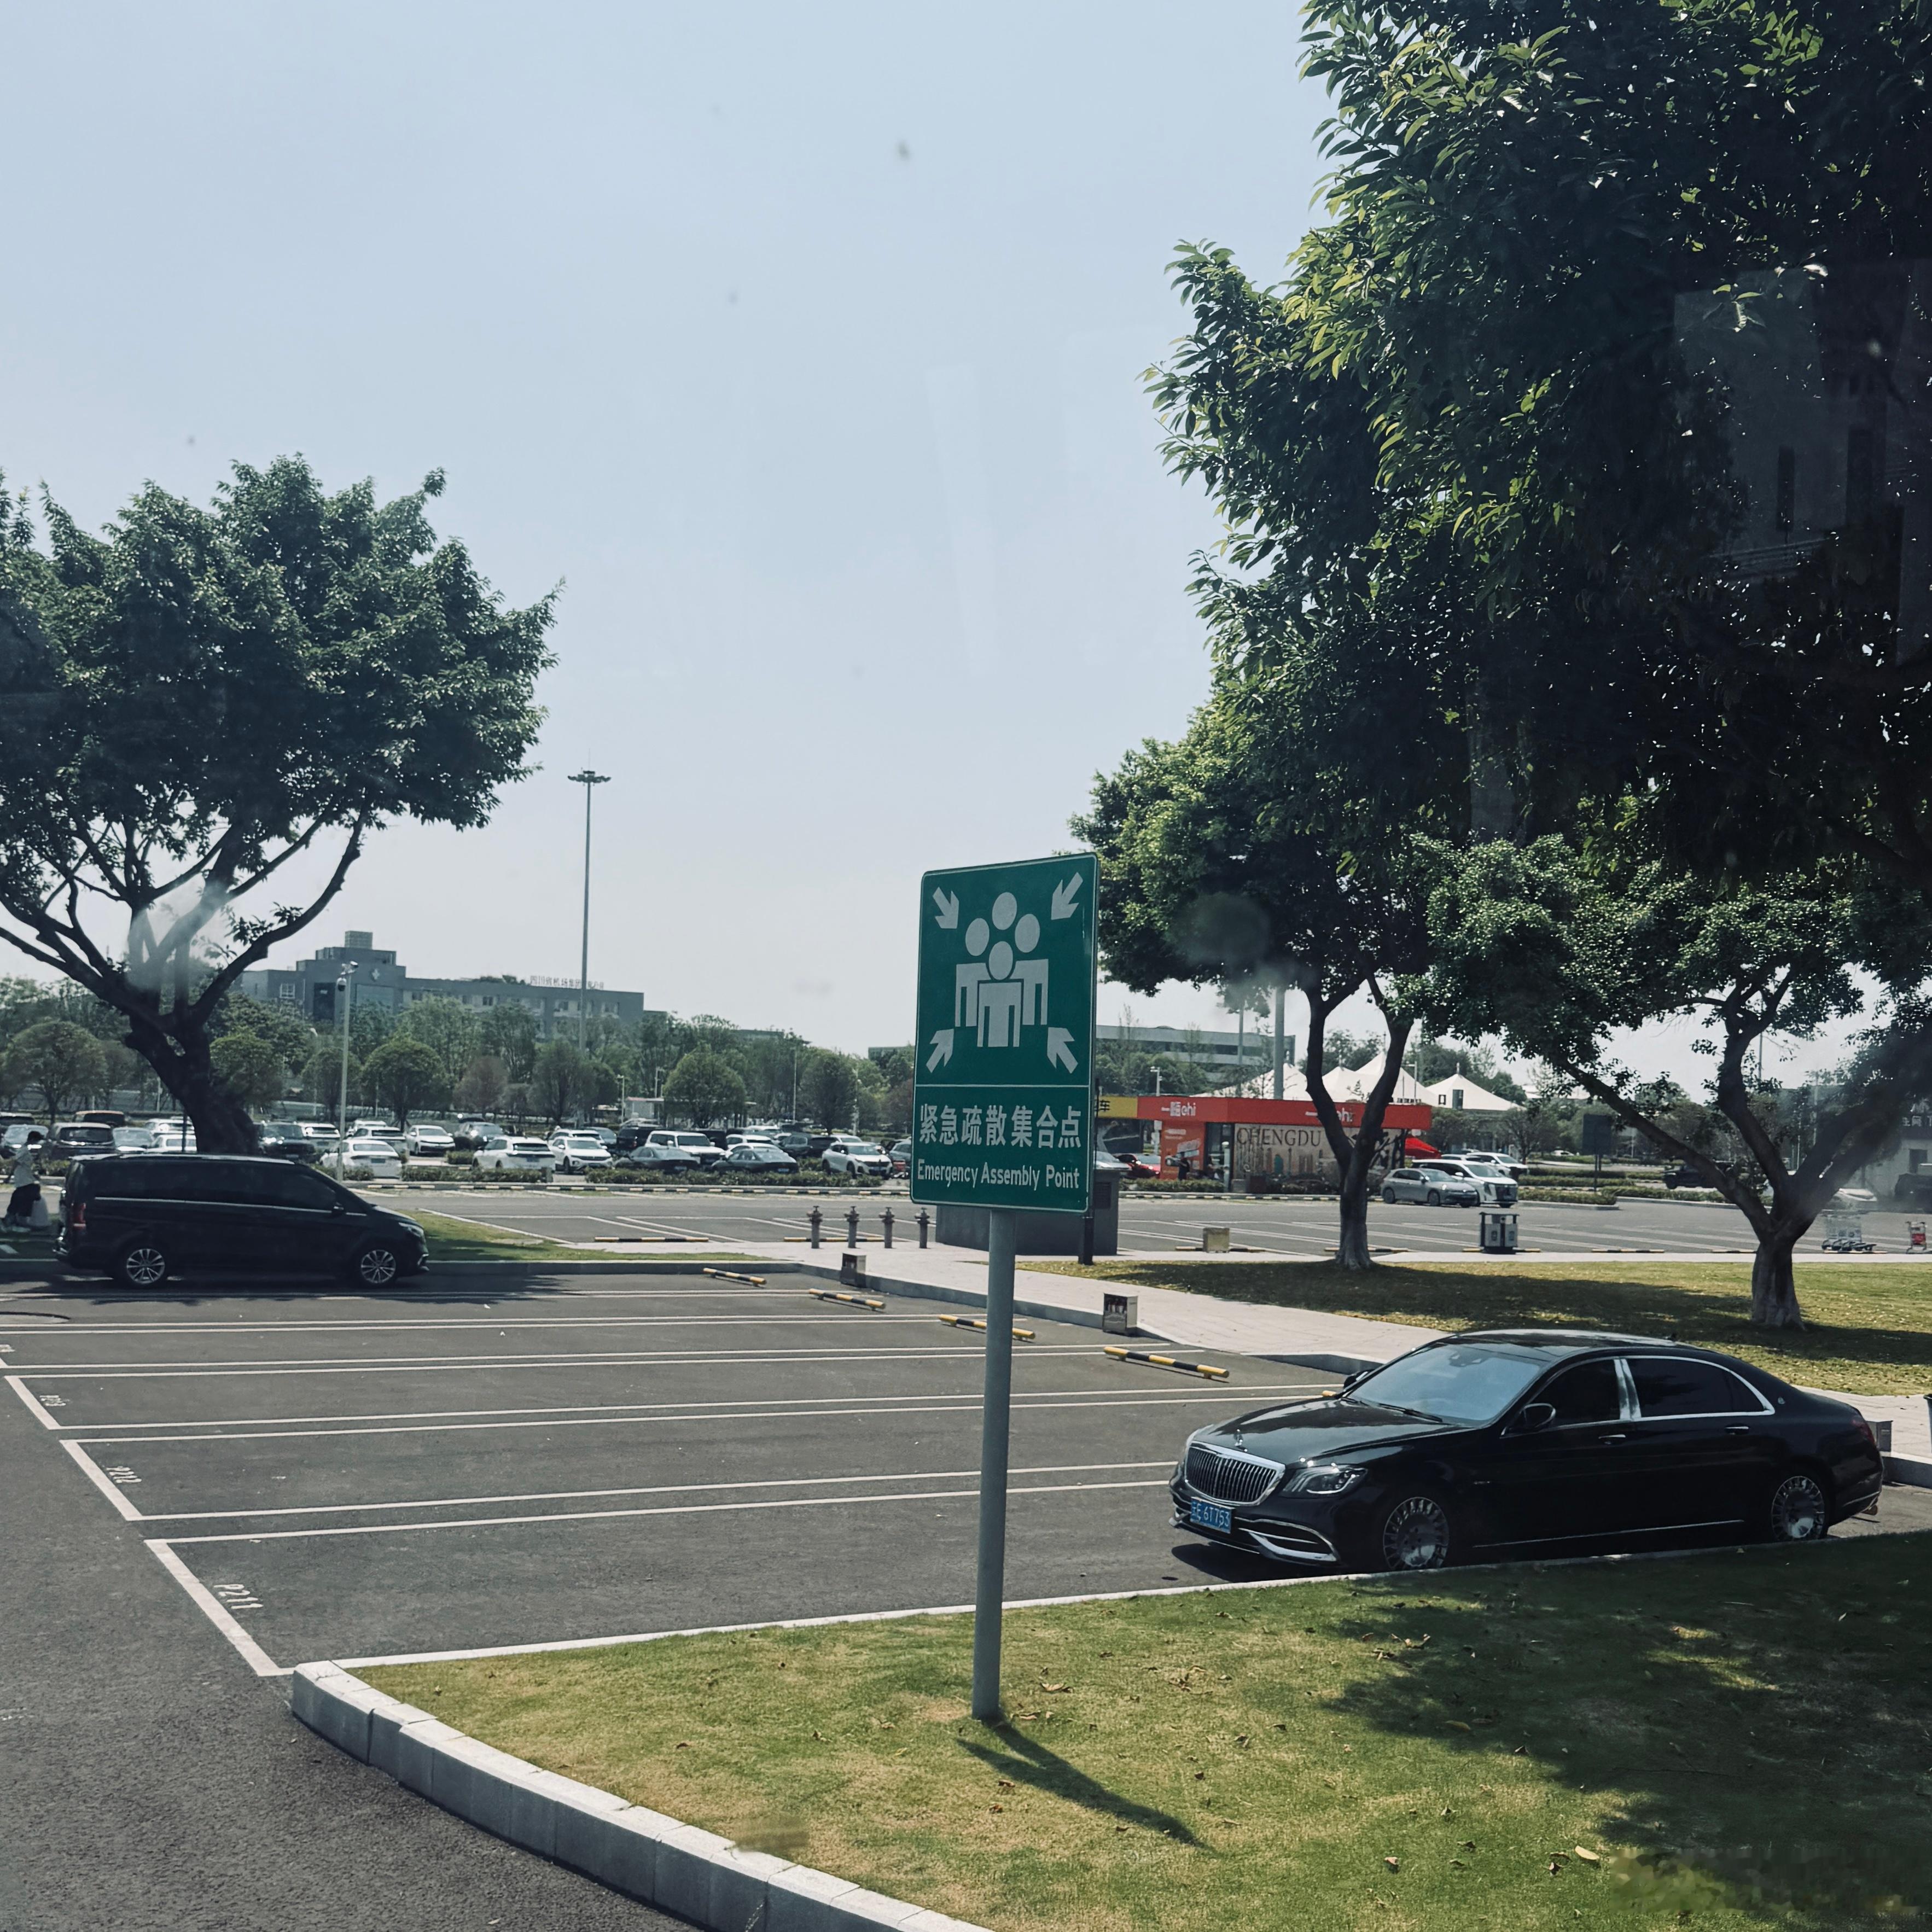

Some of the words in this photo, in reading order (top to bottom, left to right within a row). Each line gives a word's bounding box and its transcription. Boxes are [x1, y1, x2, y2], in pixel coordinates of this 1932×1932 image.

[919, 1103, 1081, 1149] 紧急疏散集合点
[917, 1159, 979, 1189] Emergency
[981, 1161, 1040, 1191] Assembly
[1046, 1164, 1080, 1189] Point
